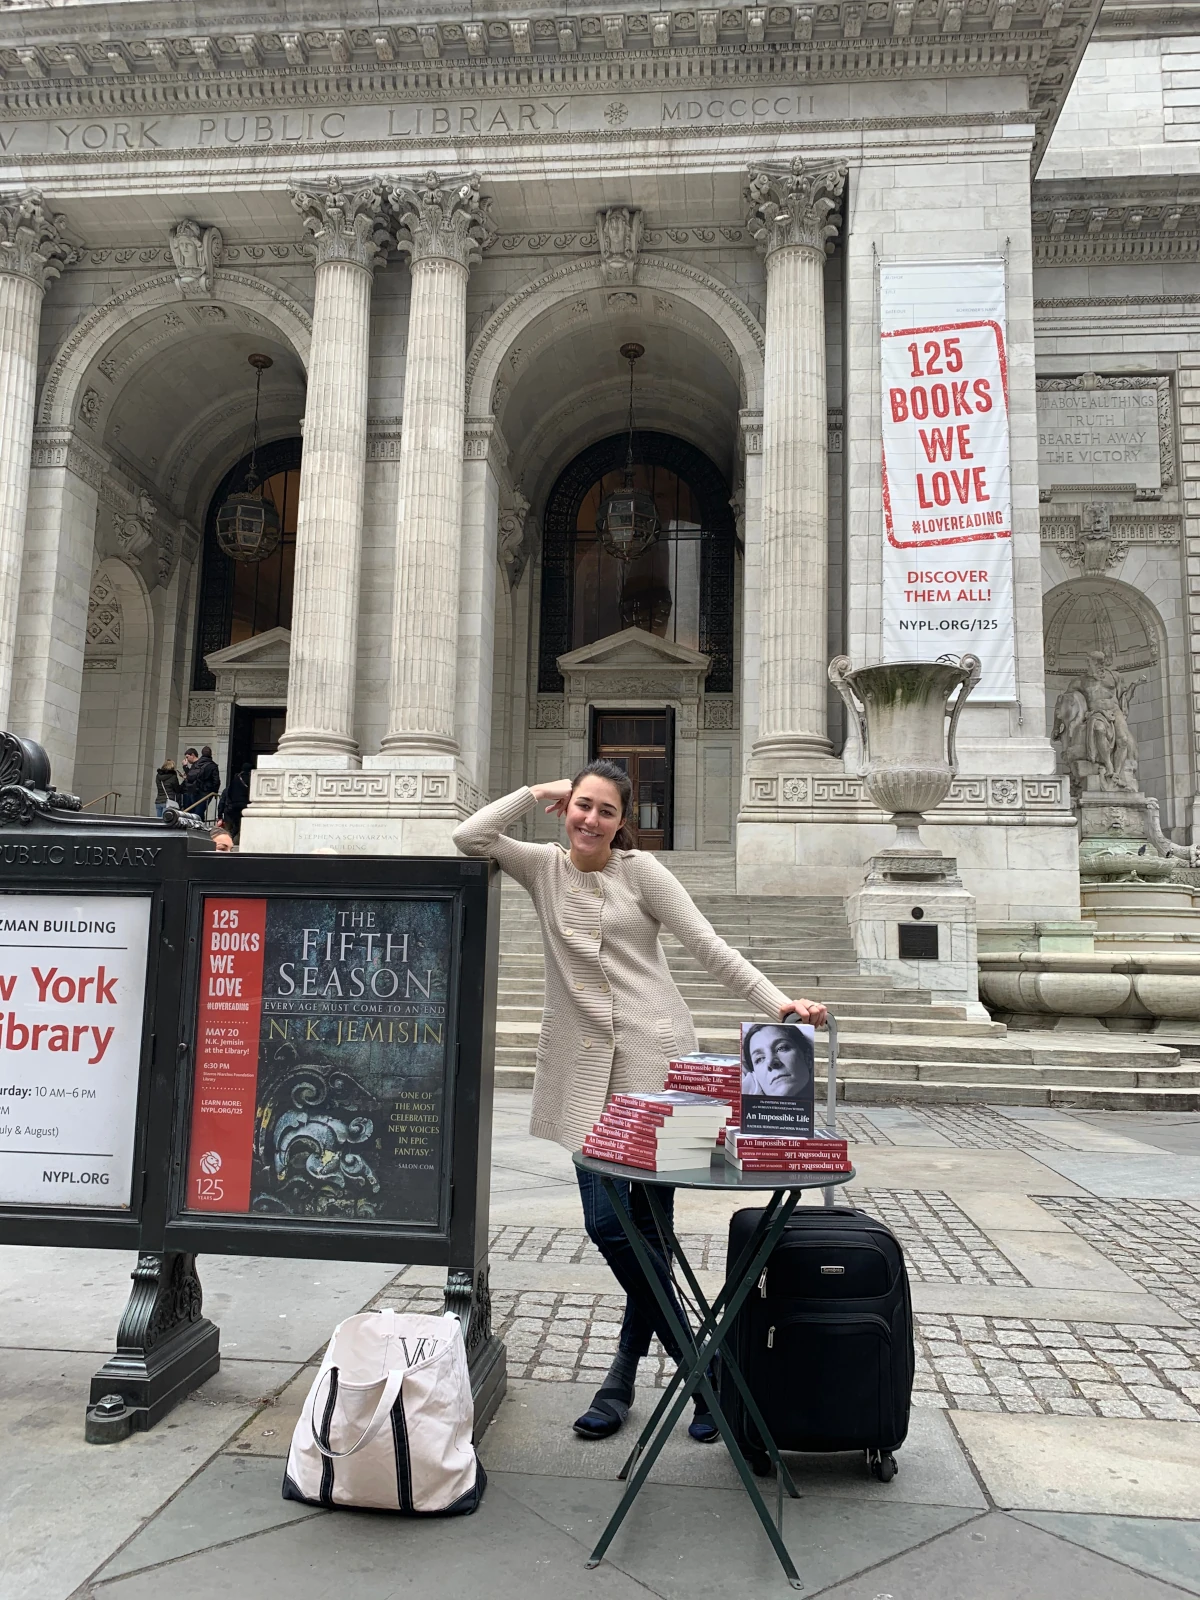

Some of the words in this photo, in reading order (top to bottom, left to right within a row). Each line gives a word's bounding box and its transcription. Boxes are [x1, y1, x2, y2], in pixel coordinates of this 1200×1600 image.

[55, 121, 162, 151] YORK
[198, 113, 346, 145] PUBLIC
[388, 102, 570, 136] LIBRARY
[662, 96, 815, 121] MDCCCCII
[908, 337, 963, 377] 125
[889, 378, 993, 422] BOOKS
[1051, 397, 1087, 408] ABOVE
[1090, 396, 1110, 408] ALL
[1111, 395, 1154, 407] THINGS
[1067, 414, 1115, 427] TRUTH
[918, 424, 974, 463] WE
[1039, 433, 1101, 445] BEARETH
[1107, 431, 1146, 444] AWAY
[1046, 451, 1074, 463] THE
[1079, 449, 1141, 462] VICTORY
[916, 466, 990, 509] LOVE
[912, 510, 1003, 534] #LOVEREADING
[907, 570, 988, 584] DISCOVER
[904, 589, 951, 602] THEM
[957, 588, 992, 602] ALL!
[899, 619, 998, 632] NYPL.ORG/125
[74, 845, 162, 866] LIBRARY
[212, 909, 239, 929] 125
[338, 911, 376, 928] THE
[44, 920, 116, 933] BUILDING
[211, 932, 260, 952] BOOKS
[301, 928, 410, 963] FIFTH
[210, 955, 234, 974] WE
[31, 966, 119, 1004] York
[209, 977, 242, 997] LOVE
[278, 962, 432, 999] SEASON
[207, 1002, 249, 1011] #LOVEREADING
[264, 1002, 295, 1010] EVERY
[298, 1002, 318, 1011] AGE
[322, 1003, 349, 1012] MUST
[353, 1004, 383, 1013] COME
[386, 1005, 401, 1013] TO
[405, 1005, 421, 1014] AN
[424, 1005, 445, 1014] END
[205, 1028, 226, 1036] MAY
[227, 1028, 239, 1037] 20
[269, 1018, 294, 1040] N.
[306, 1019, 325, 1041] K.
[337, 1020, 443, 1046] JEMISIN
[224, 1047, 249, 1056] Library!
[684, 1064, 711, 1072] Impossible
[35, 1086, 47, 1097] 10
[82, 1089, 96, 1098] PM
[679, 1083, 707, 1092] Impossible
[421, 1092, 433, 1100] OF
[395, 1102, 411, 1110] THE
[412, 1103, 435, 1111] MOST
[390, 1114, 439, 1122] CELEBRATED
[746, 1112, 757, 1120] An
[758, 1112, 795, 1122] Impossible
[796, 1114, 810, 1123] Life
[15, 1126, 21, 1135] &
[24, 1126, 59, 1138] August)
[410, 1125, 440, 1134] VOICES
[410, 1137, 428, 1145] EPIC
[798, 1151, 831, 1159] Impossible
[801, 1162, 834, 1170] Impossible
[42, 1171, 110, 1184] NYPL.ORG
[196, 1178, 224, 1201] 125
